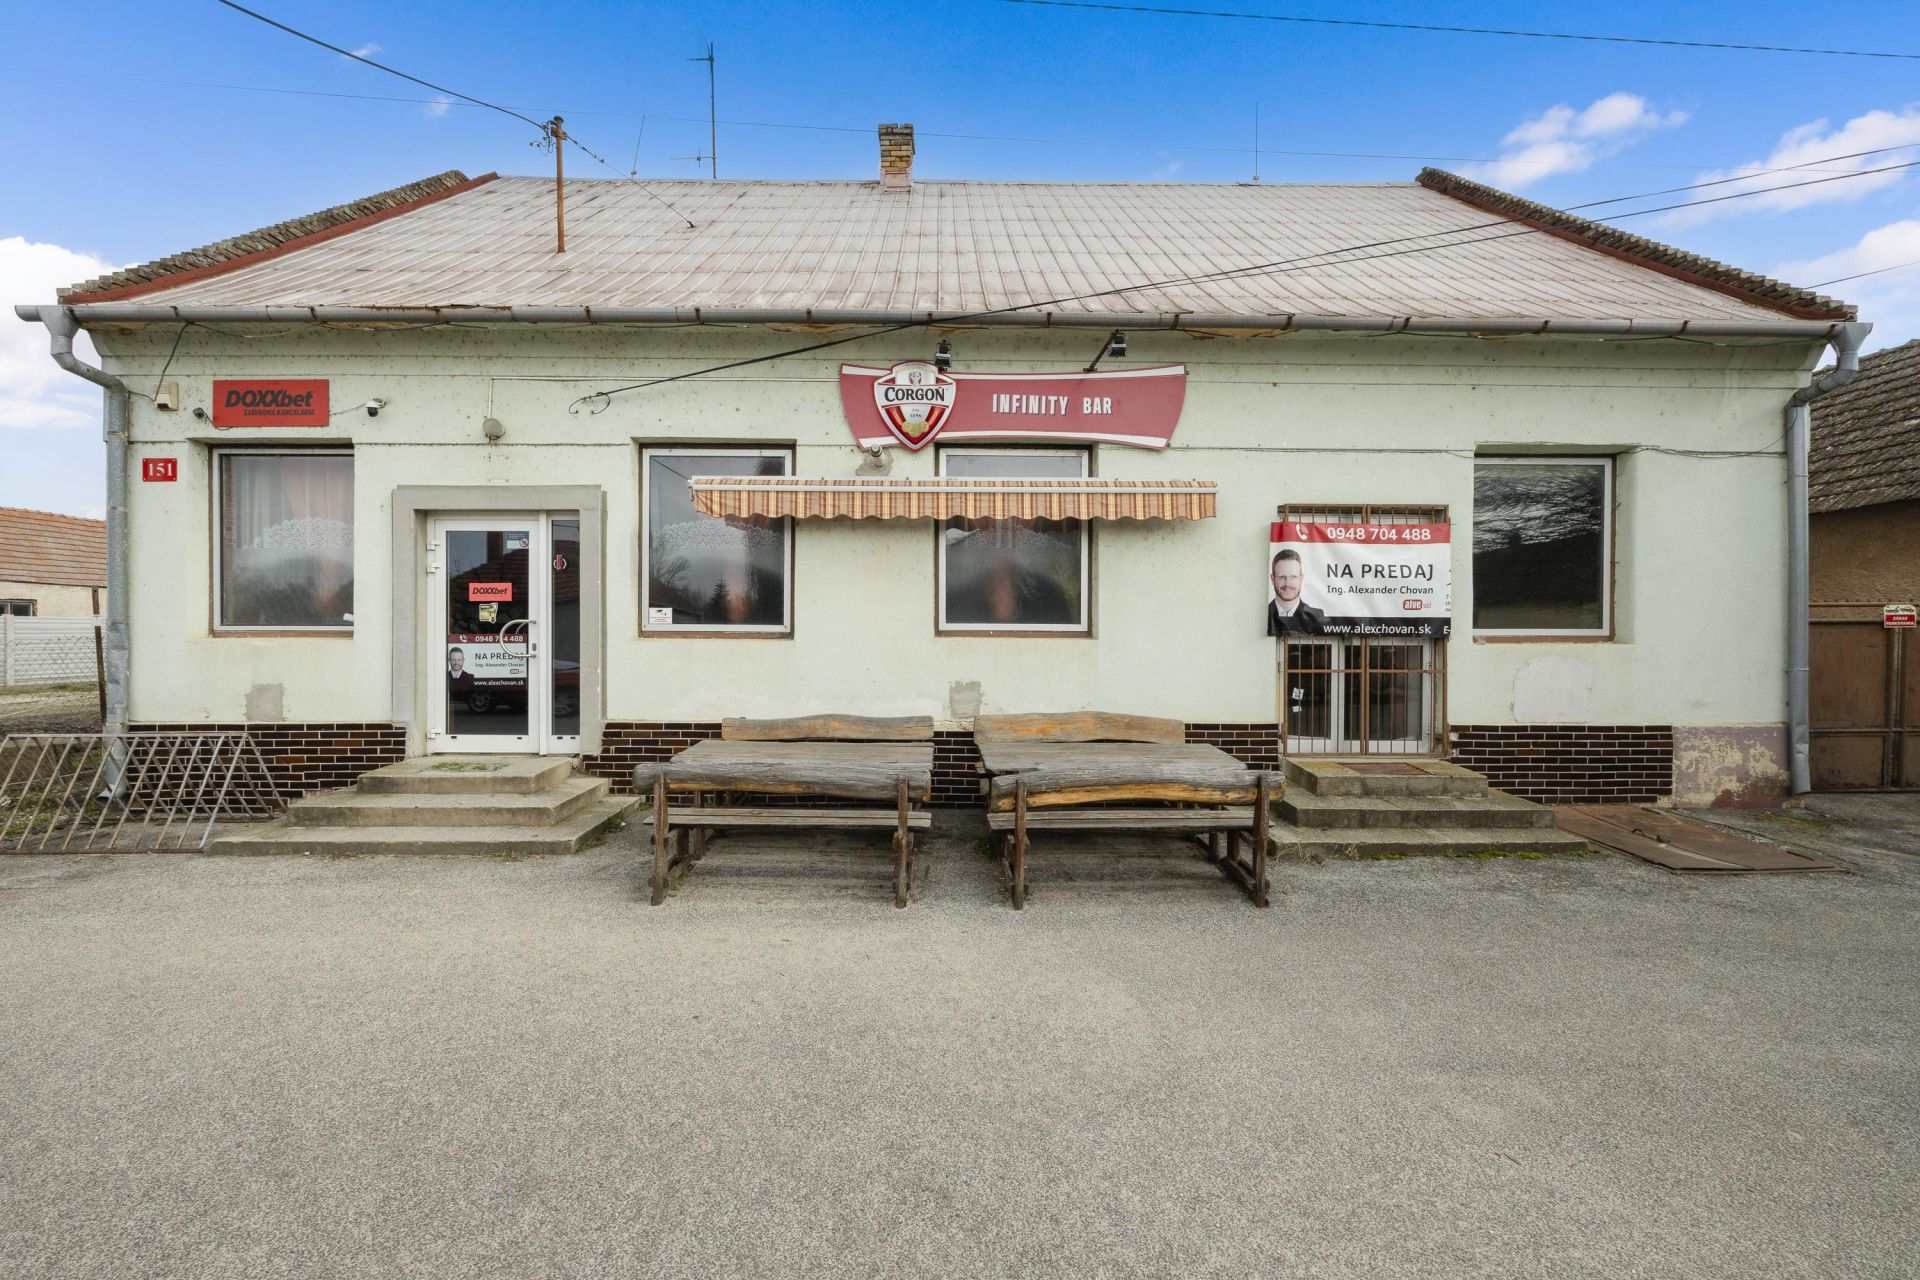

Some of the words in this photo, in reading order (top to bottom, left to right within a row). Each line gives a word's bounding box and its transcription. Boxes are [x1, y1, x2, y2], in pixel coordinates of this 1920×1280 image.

[225, 389, 314, 408] DOXXbet
[884, 386, 945, 402] CORGOŇ
[992, 394, 1069, 416] INFINITY
[1083, 397, 1113, 415] BAR
[149, 463, 173, 477] 151
[1327, 527, 1366, 540] 0948
[1371, 528, 1398, 540] 704
[1402, 528, 1432, 541] 488
[1326, 563, 1354, 579] NA
[1361, 564, 1434, 581] PREDAJ
[472, 587, 508, 595] DOXXbet
[1327, 585, 1346, 596] Ing.
[1348, 585, 1397, 595] Alexander
[1400, 586, 1434, 595] Chovan
[1323, 623, 1432, 635] www.alexchovan.sk
[475, 652, 488, 660] NA
